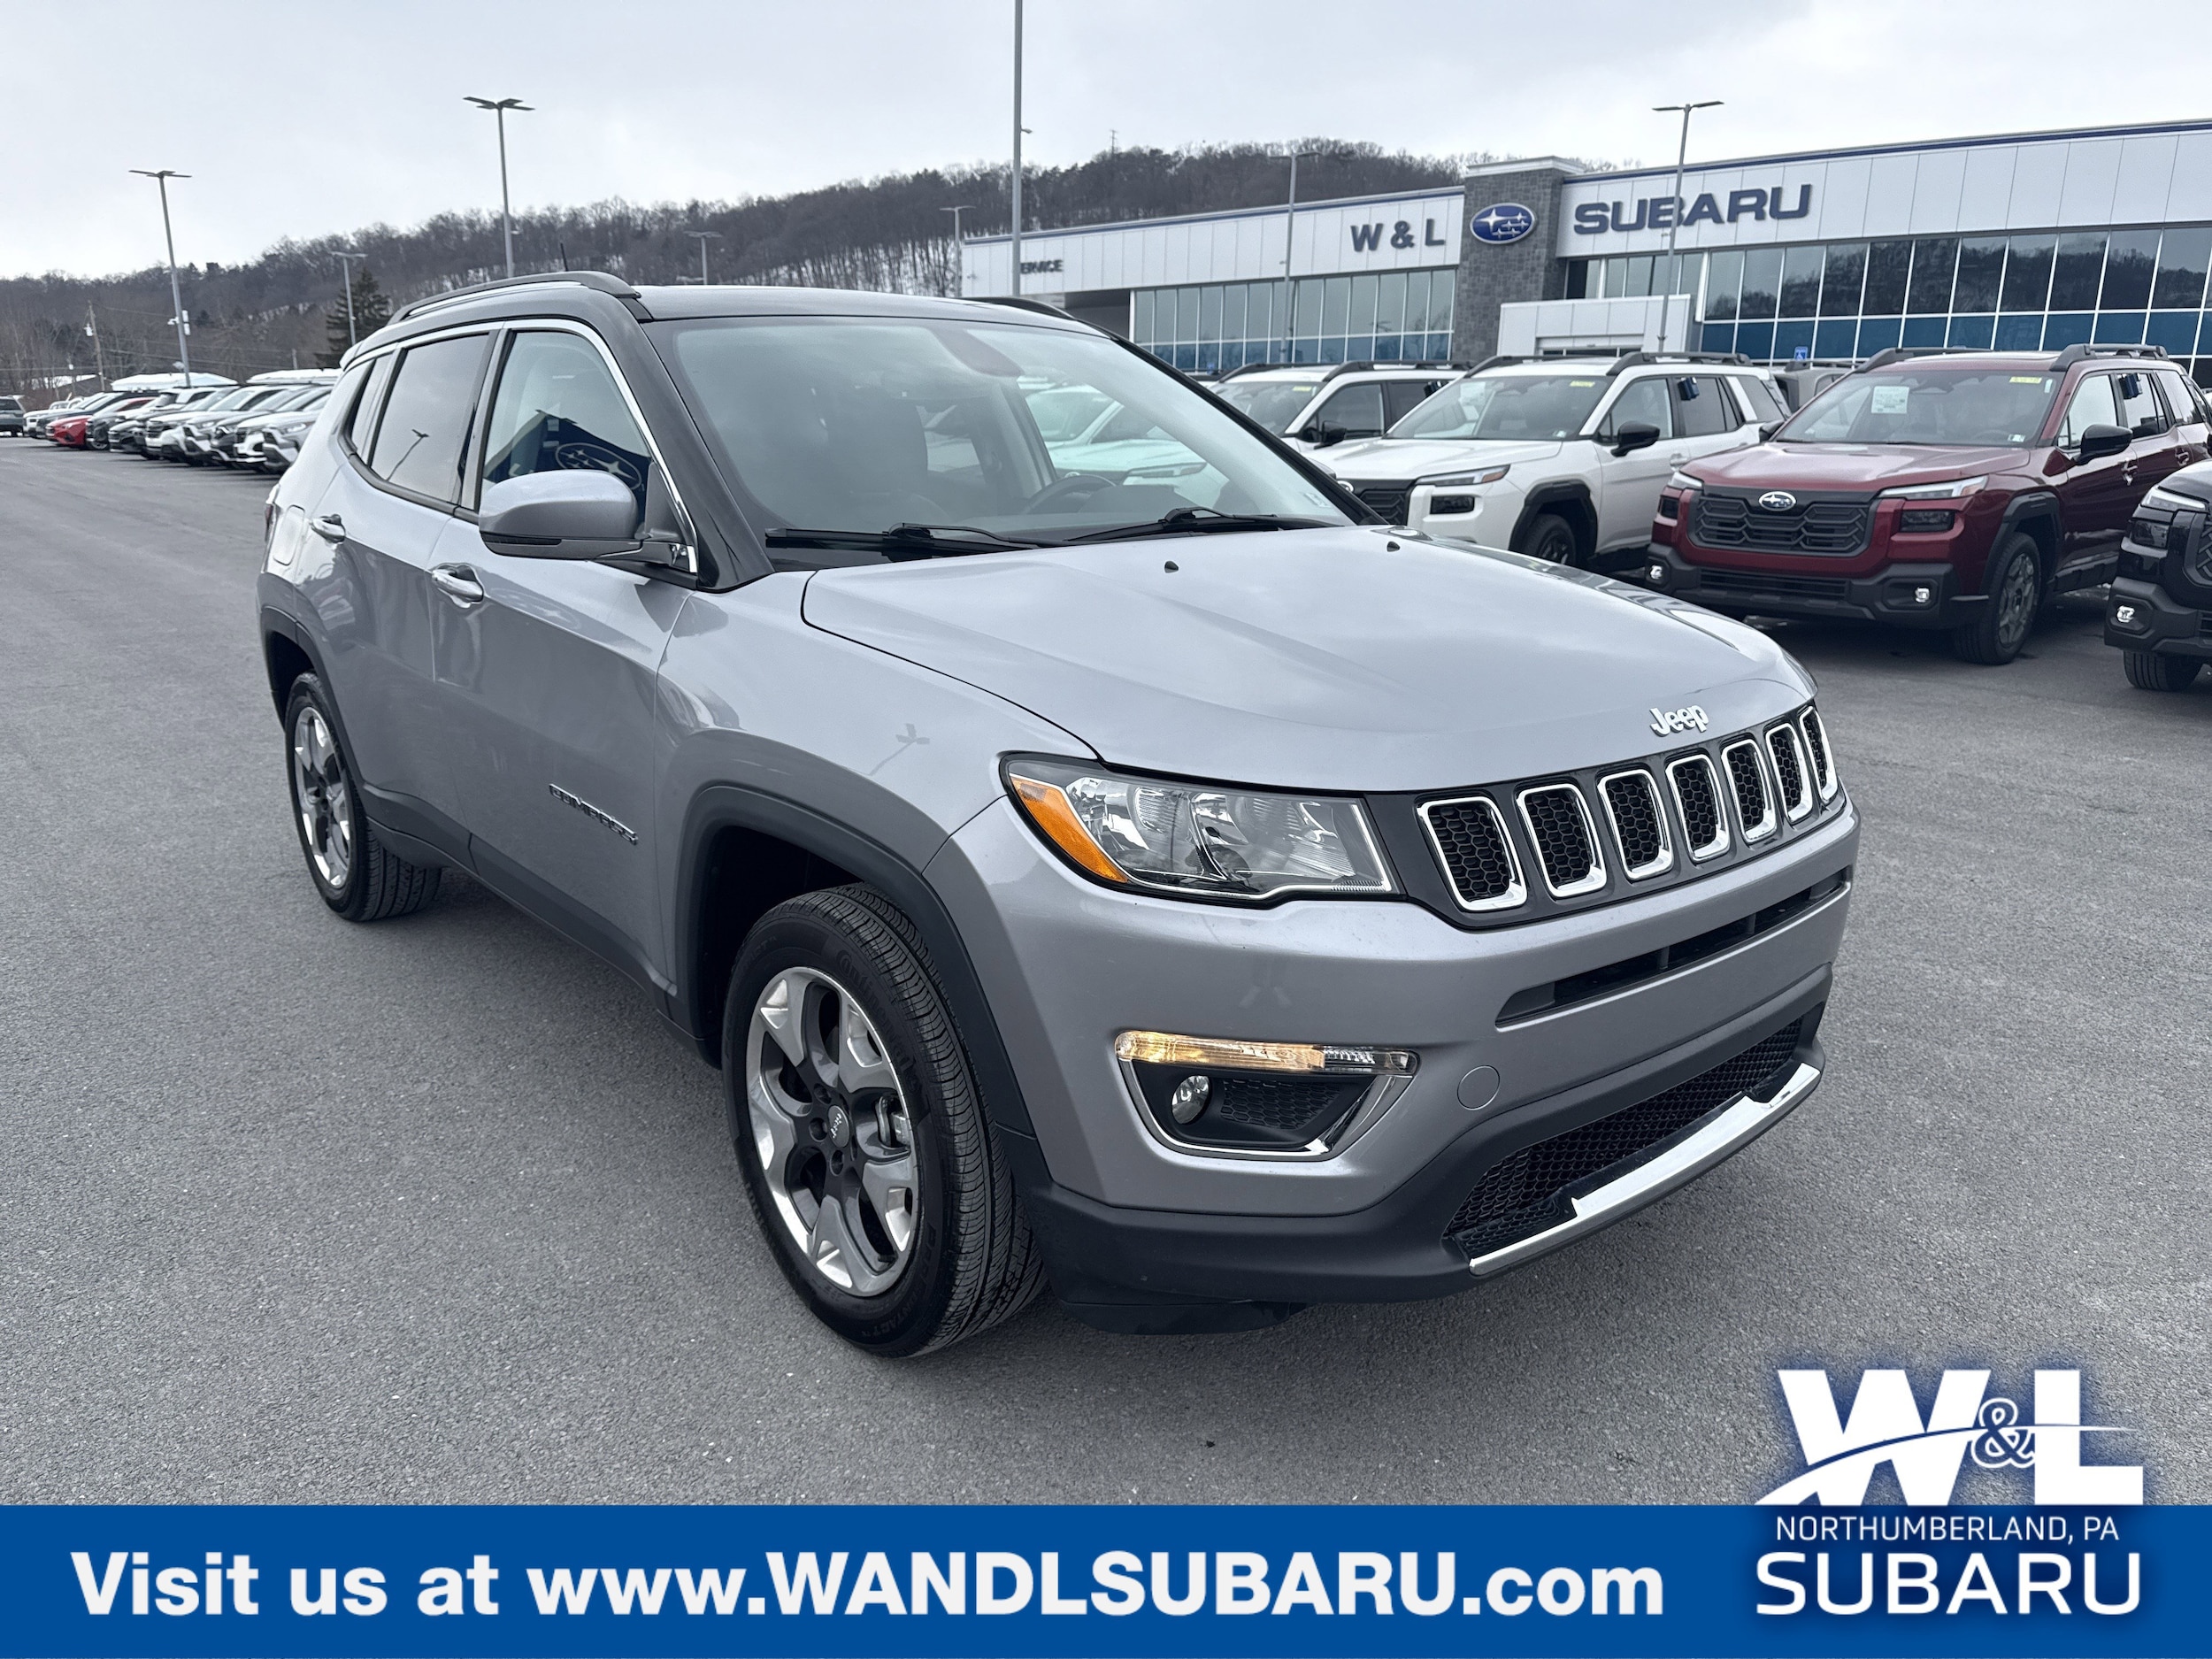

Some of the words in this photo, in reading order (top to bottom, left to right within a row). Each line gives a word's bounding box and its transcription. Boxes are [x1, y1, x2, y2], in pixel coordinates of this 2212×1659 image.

[1574, 184, 1812, 235] SUBARU
[1350, 223, 1384, 252] W
[1390, 220, 1415, 249] &
[1425, 218, 1446, 246] L
[1649, 705, 1709, 737] Jeep
